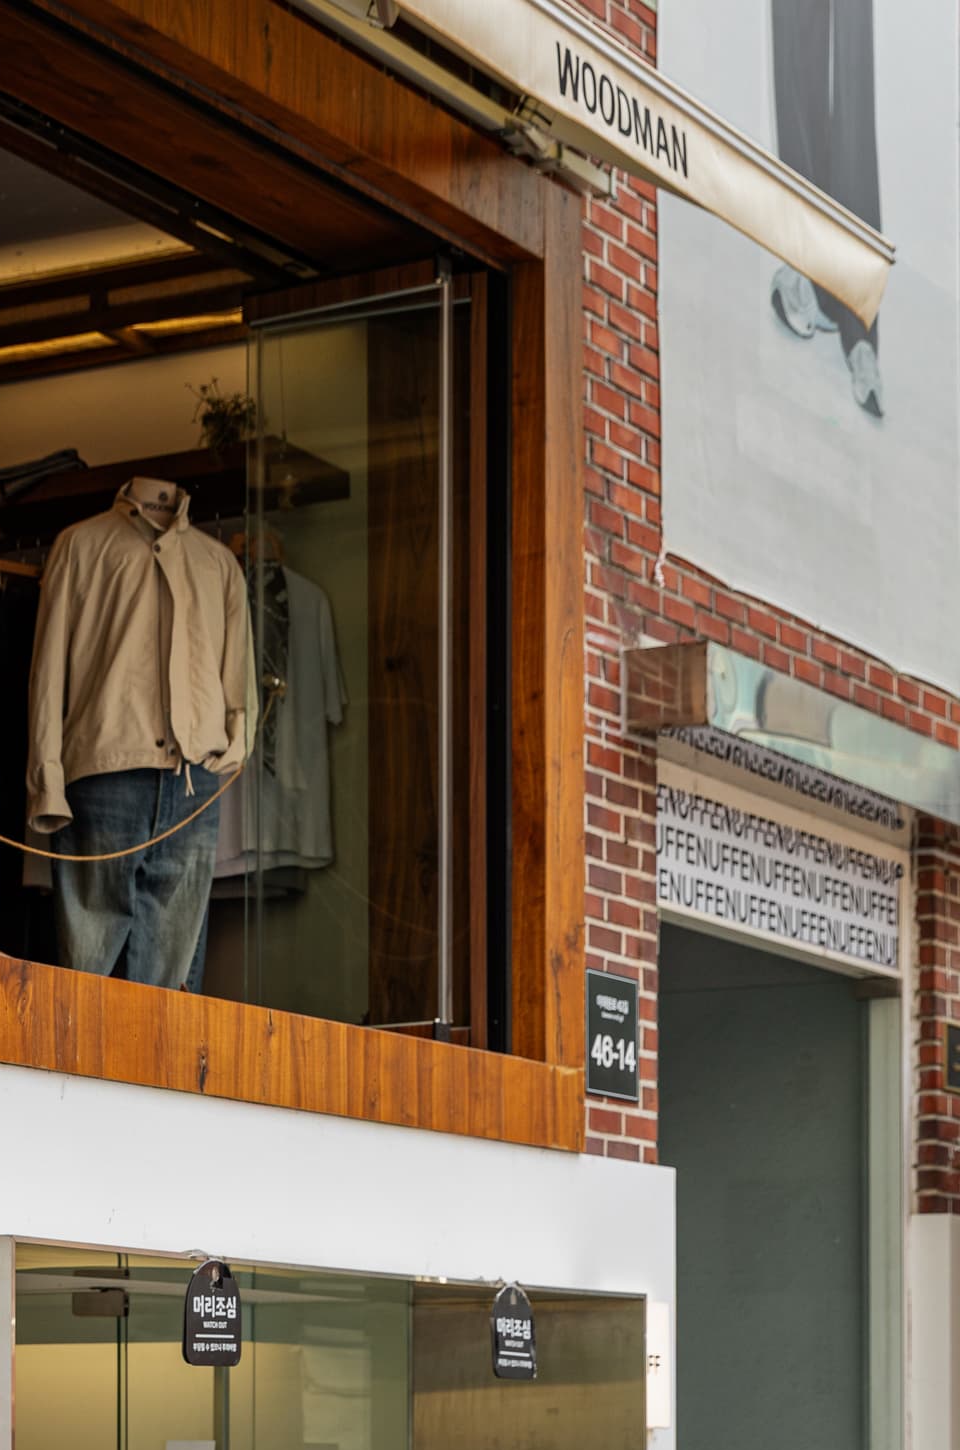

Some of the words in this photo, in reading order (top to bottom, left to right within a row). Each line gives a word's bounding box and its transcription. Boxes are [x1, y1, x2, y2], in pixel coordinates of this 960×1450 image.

[556, 40, 688, 178] WOODMAN
[193, 1294, 237, 1318] 머리조심
[496, 1317, 531, 1340] 머리조심
